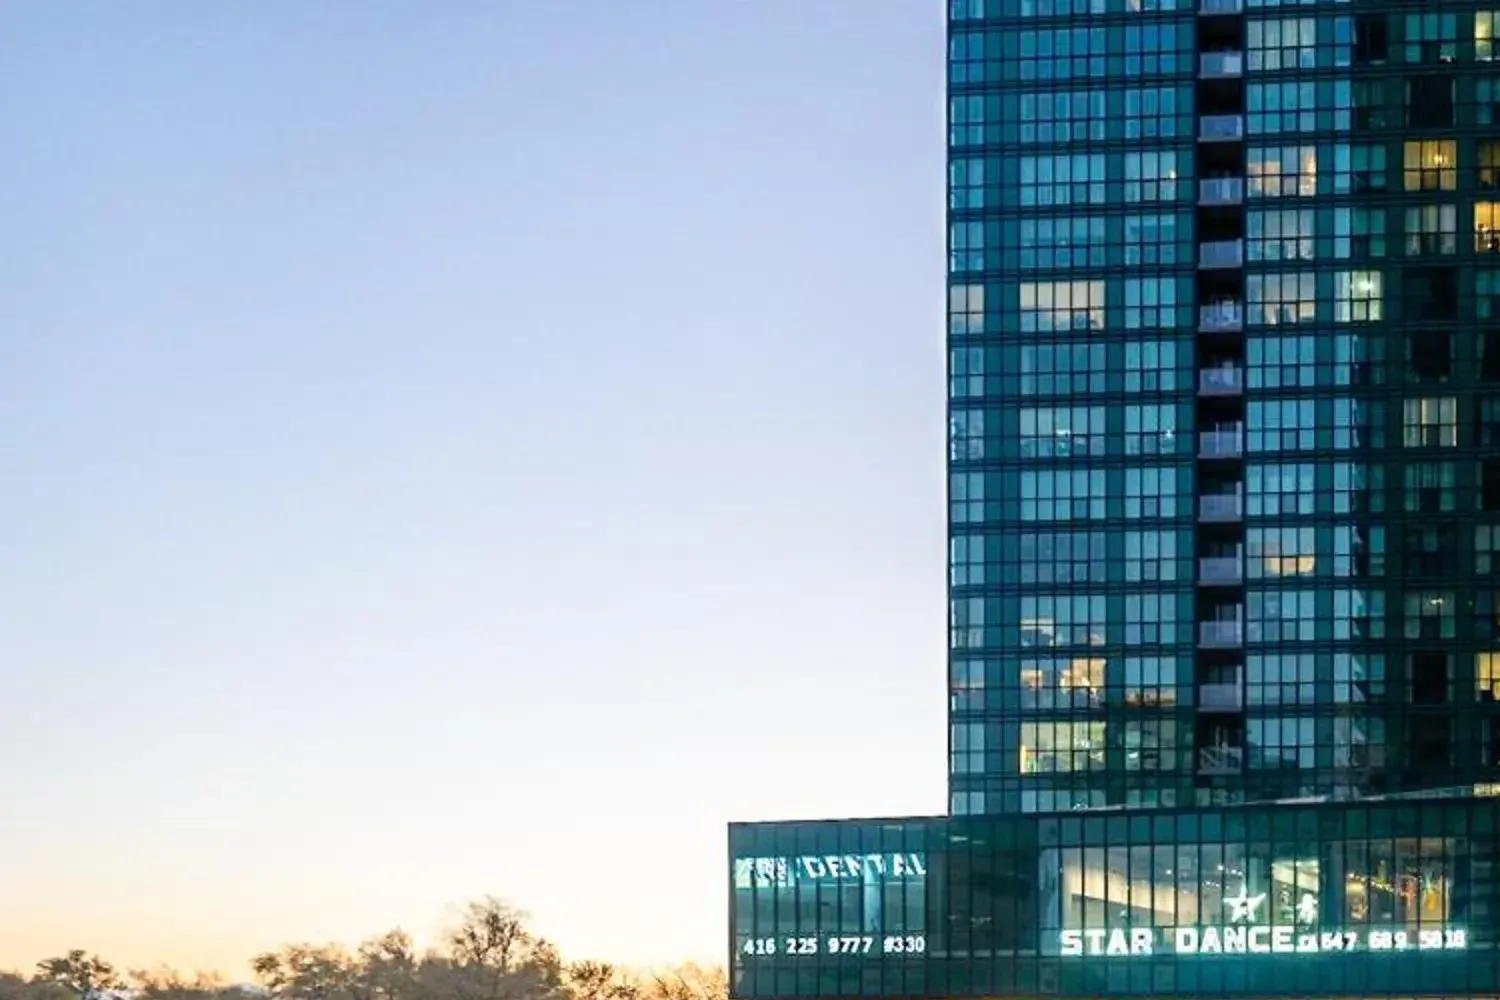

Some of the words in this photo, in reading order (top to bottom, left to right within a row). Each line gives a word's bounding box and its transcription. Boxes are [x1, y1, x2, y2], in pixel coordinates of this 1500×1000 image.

[743, 938, 776, 955] 416
[786, 937, 818, 954] 225
[828, 937, 873, 953] 9777
[1060, 927, 1153, 955] STAR
